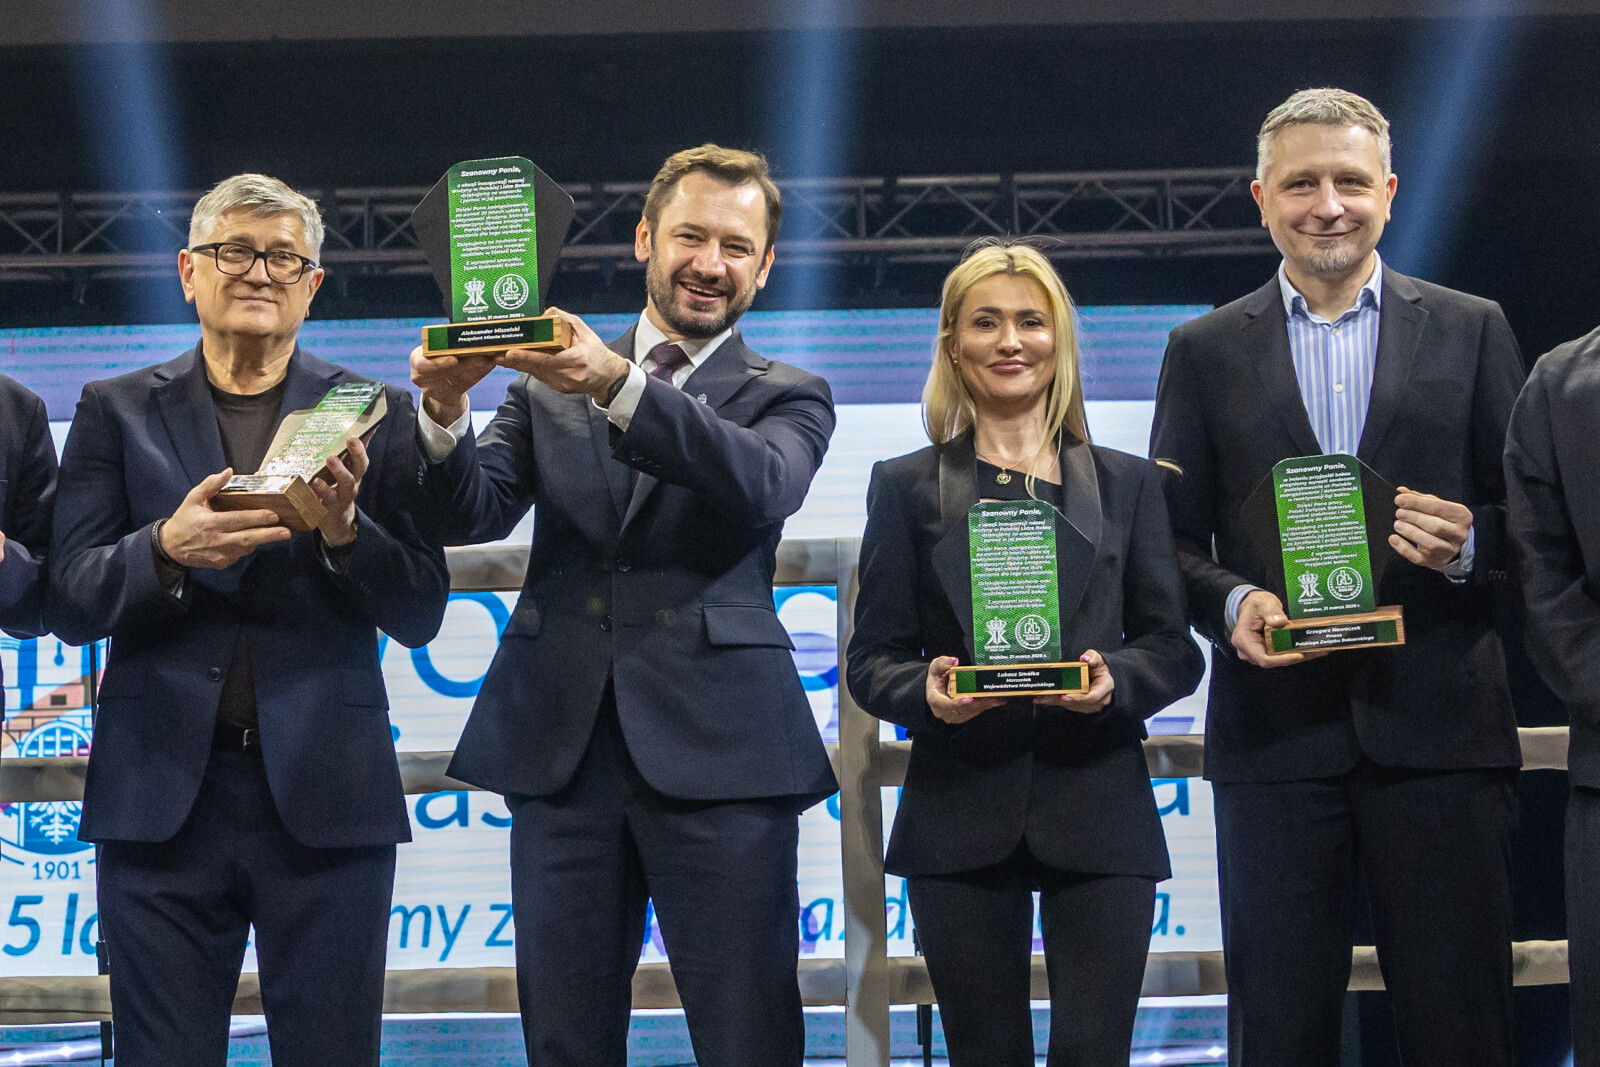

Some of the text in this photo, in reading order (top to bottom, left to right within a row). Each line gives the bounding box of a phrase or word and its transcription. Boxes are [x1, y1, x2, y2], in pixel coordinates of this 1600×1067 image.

[461, 169, 498, 177] Szanowny
[1285, 466, 1323, 474] Szanowny
[32, 862, 81, 880] 1901
